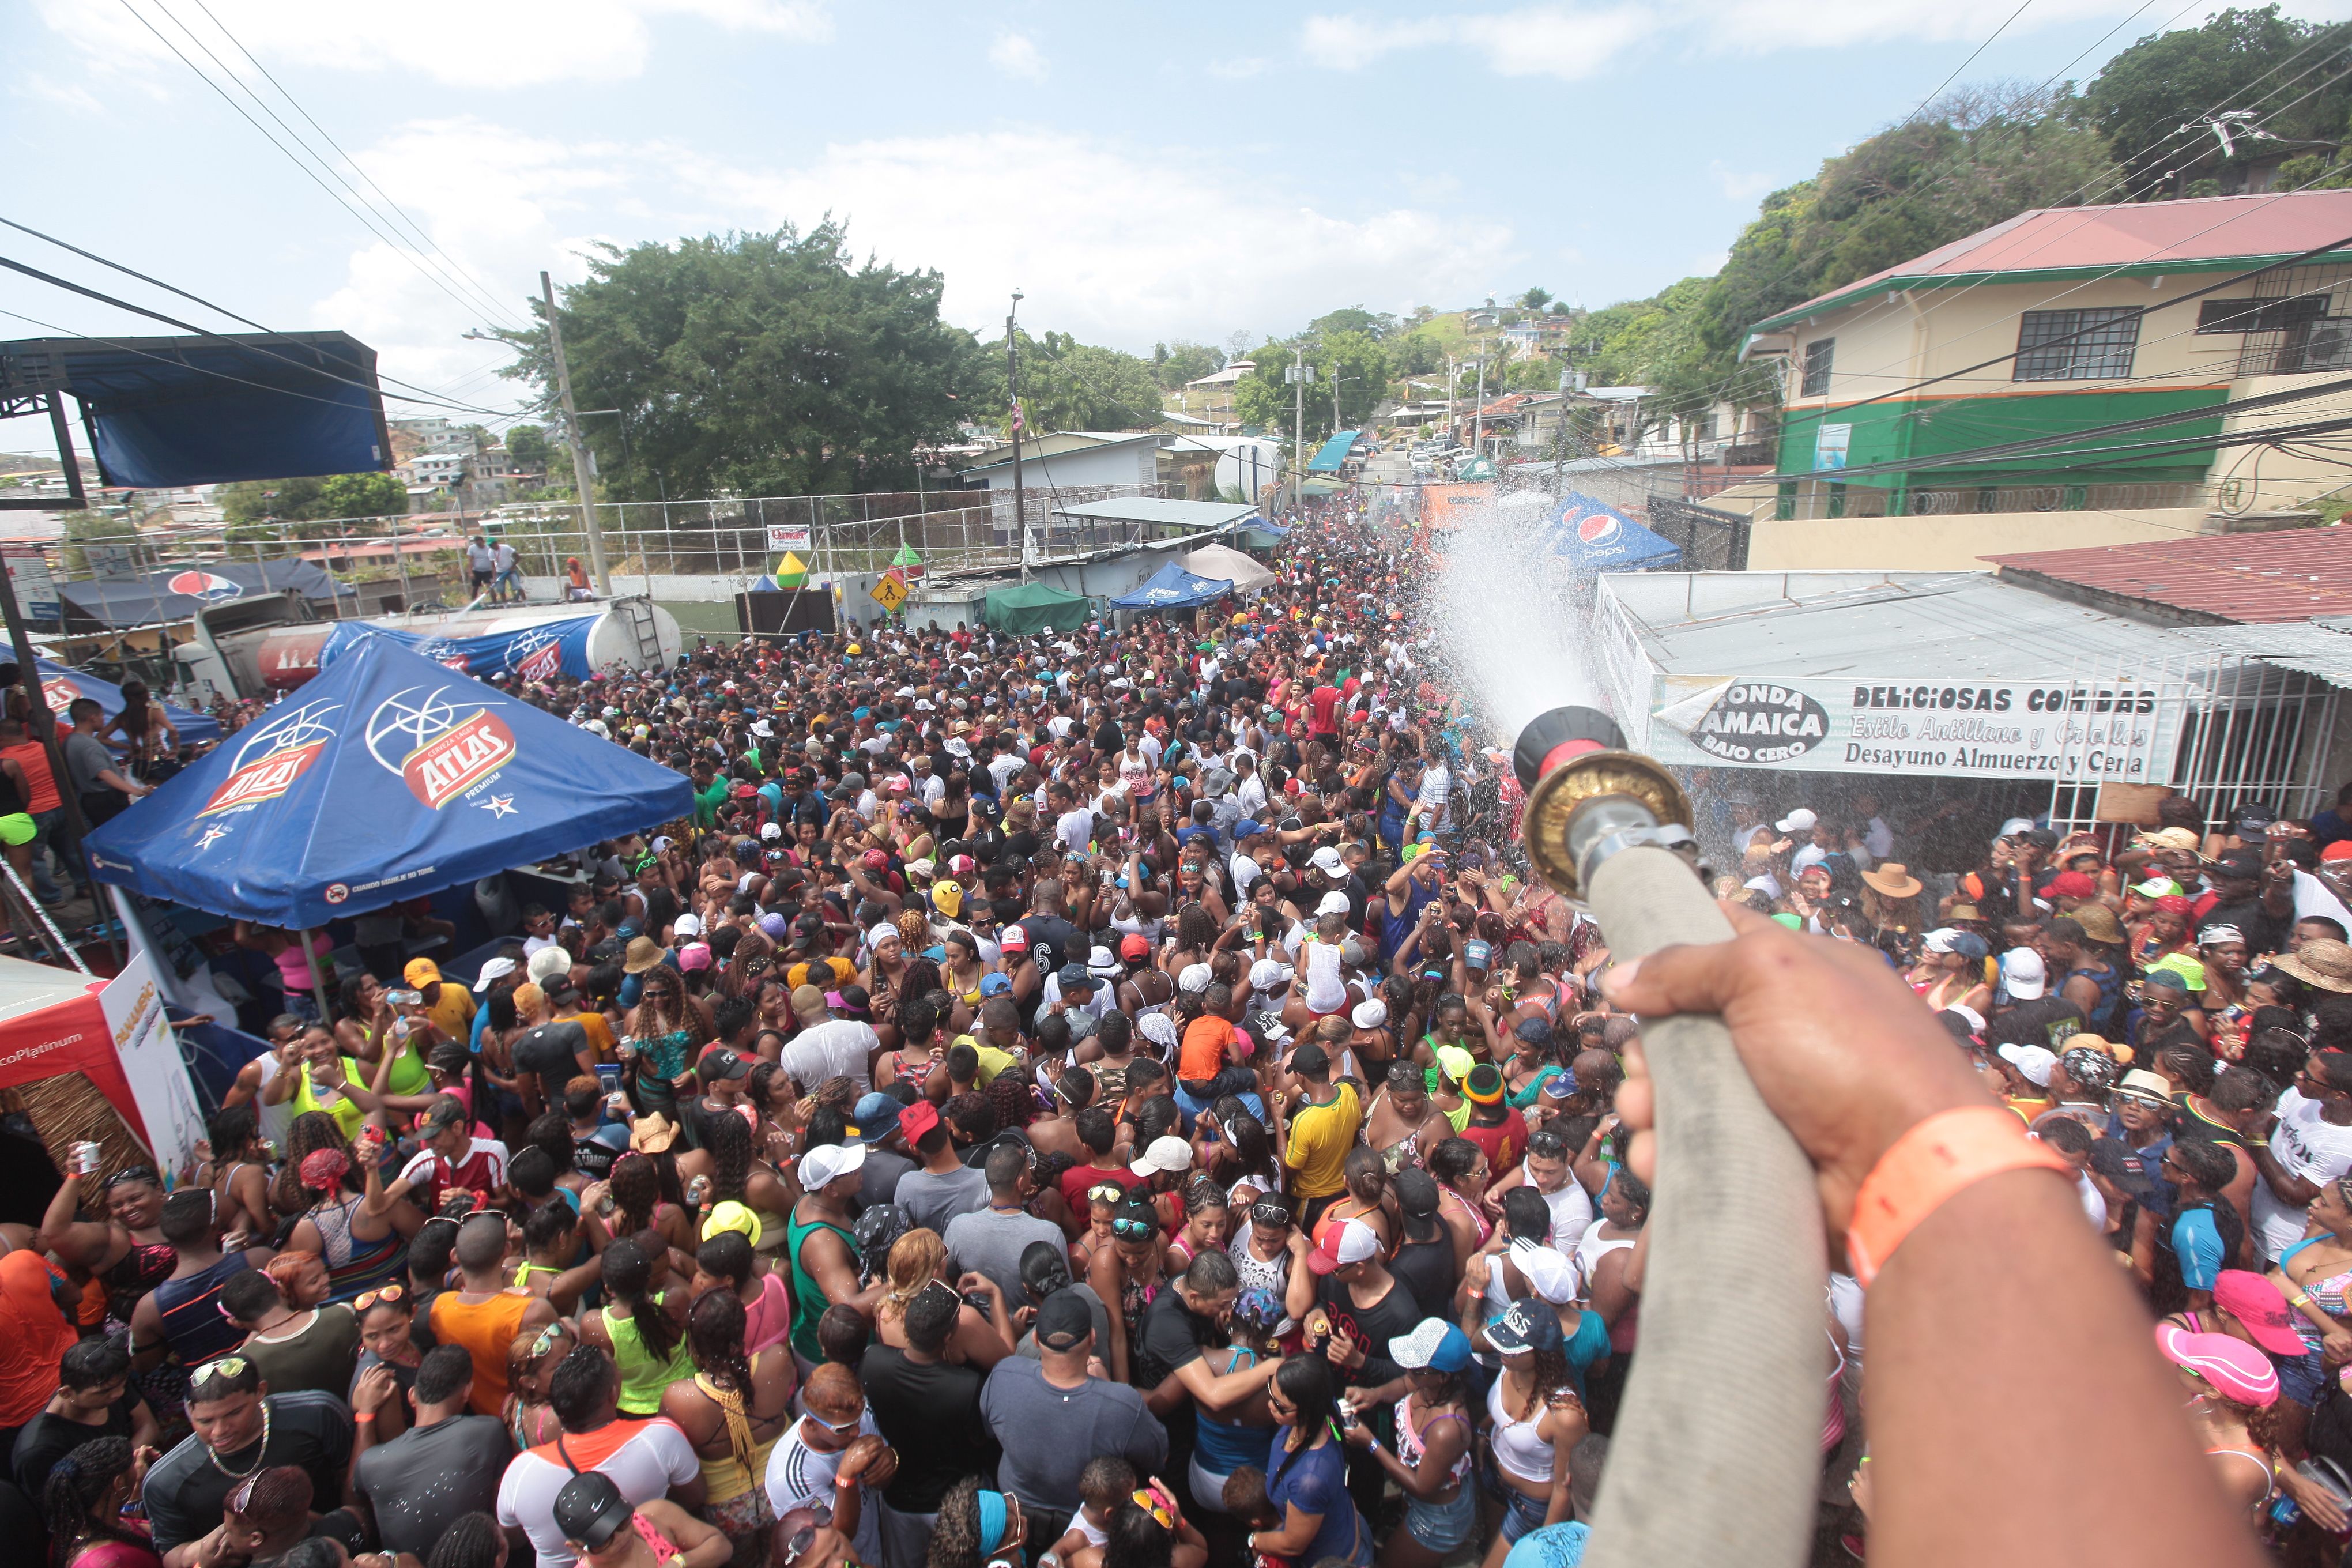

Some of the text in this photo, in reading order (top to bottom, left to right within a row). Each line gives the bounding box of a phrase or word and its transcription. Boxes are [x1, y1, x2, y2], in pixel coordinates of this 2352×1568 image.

[1585, 545, 1626, 560] pepsi
[1693, 711, 1823, 737] AMAICA
[1850, 714, 1910, 740] Estilo
[1917, 716, 2022, 744] Antillano
[2031, 727, 2045, 749] y
[428, 725, 475, 757] CERVEZA LAGER
[1702, 734, 1807, 762] BAJO CERO
[415, 725, 508, 802] ATLAS
[1845, 742, 1947, 768] Desayuno
[1952, 747, 2060, 771] Almuerzo
[2066, 755, 2080, 775] y
[209, 753, 308, 809] ATLAS
[465, 771, 502, 800] PREMIUM
[1130, 780, 1147, 789] OVE
[469, 798, 489, 808] DESDE
[352, 880, 380, 893] CUANDO
[380, 873, 407, 887] MANEJE
[408, 870, 417, 880] NO
[1034, 942, 1051, 975] 6
